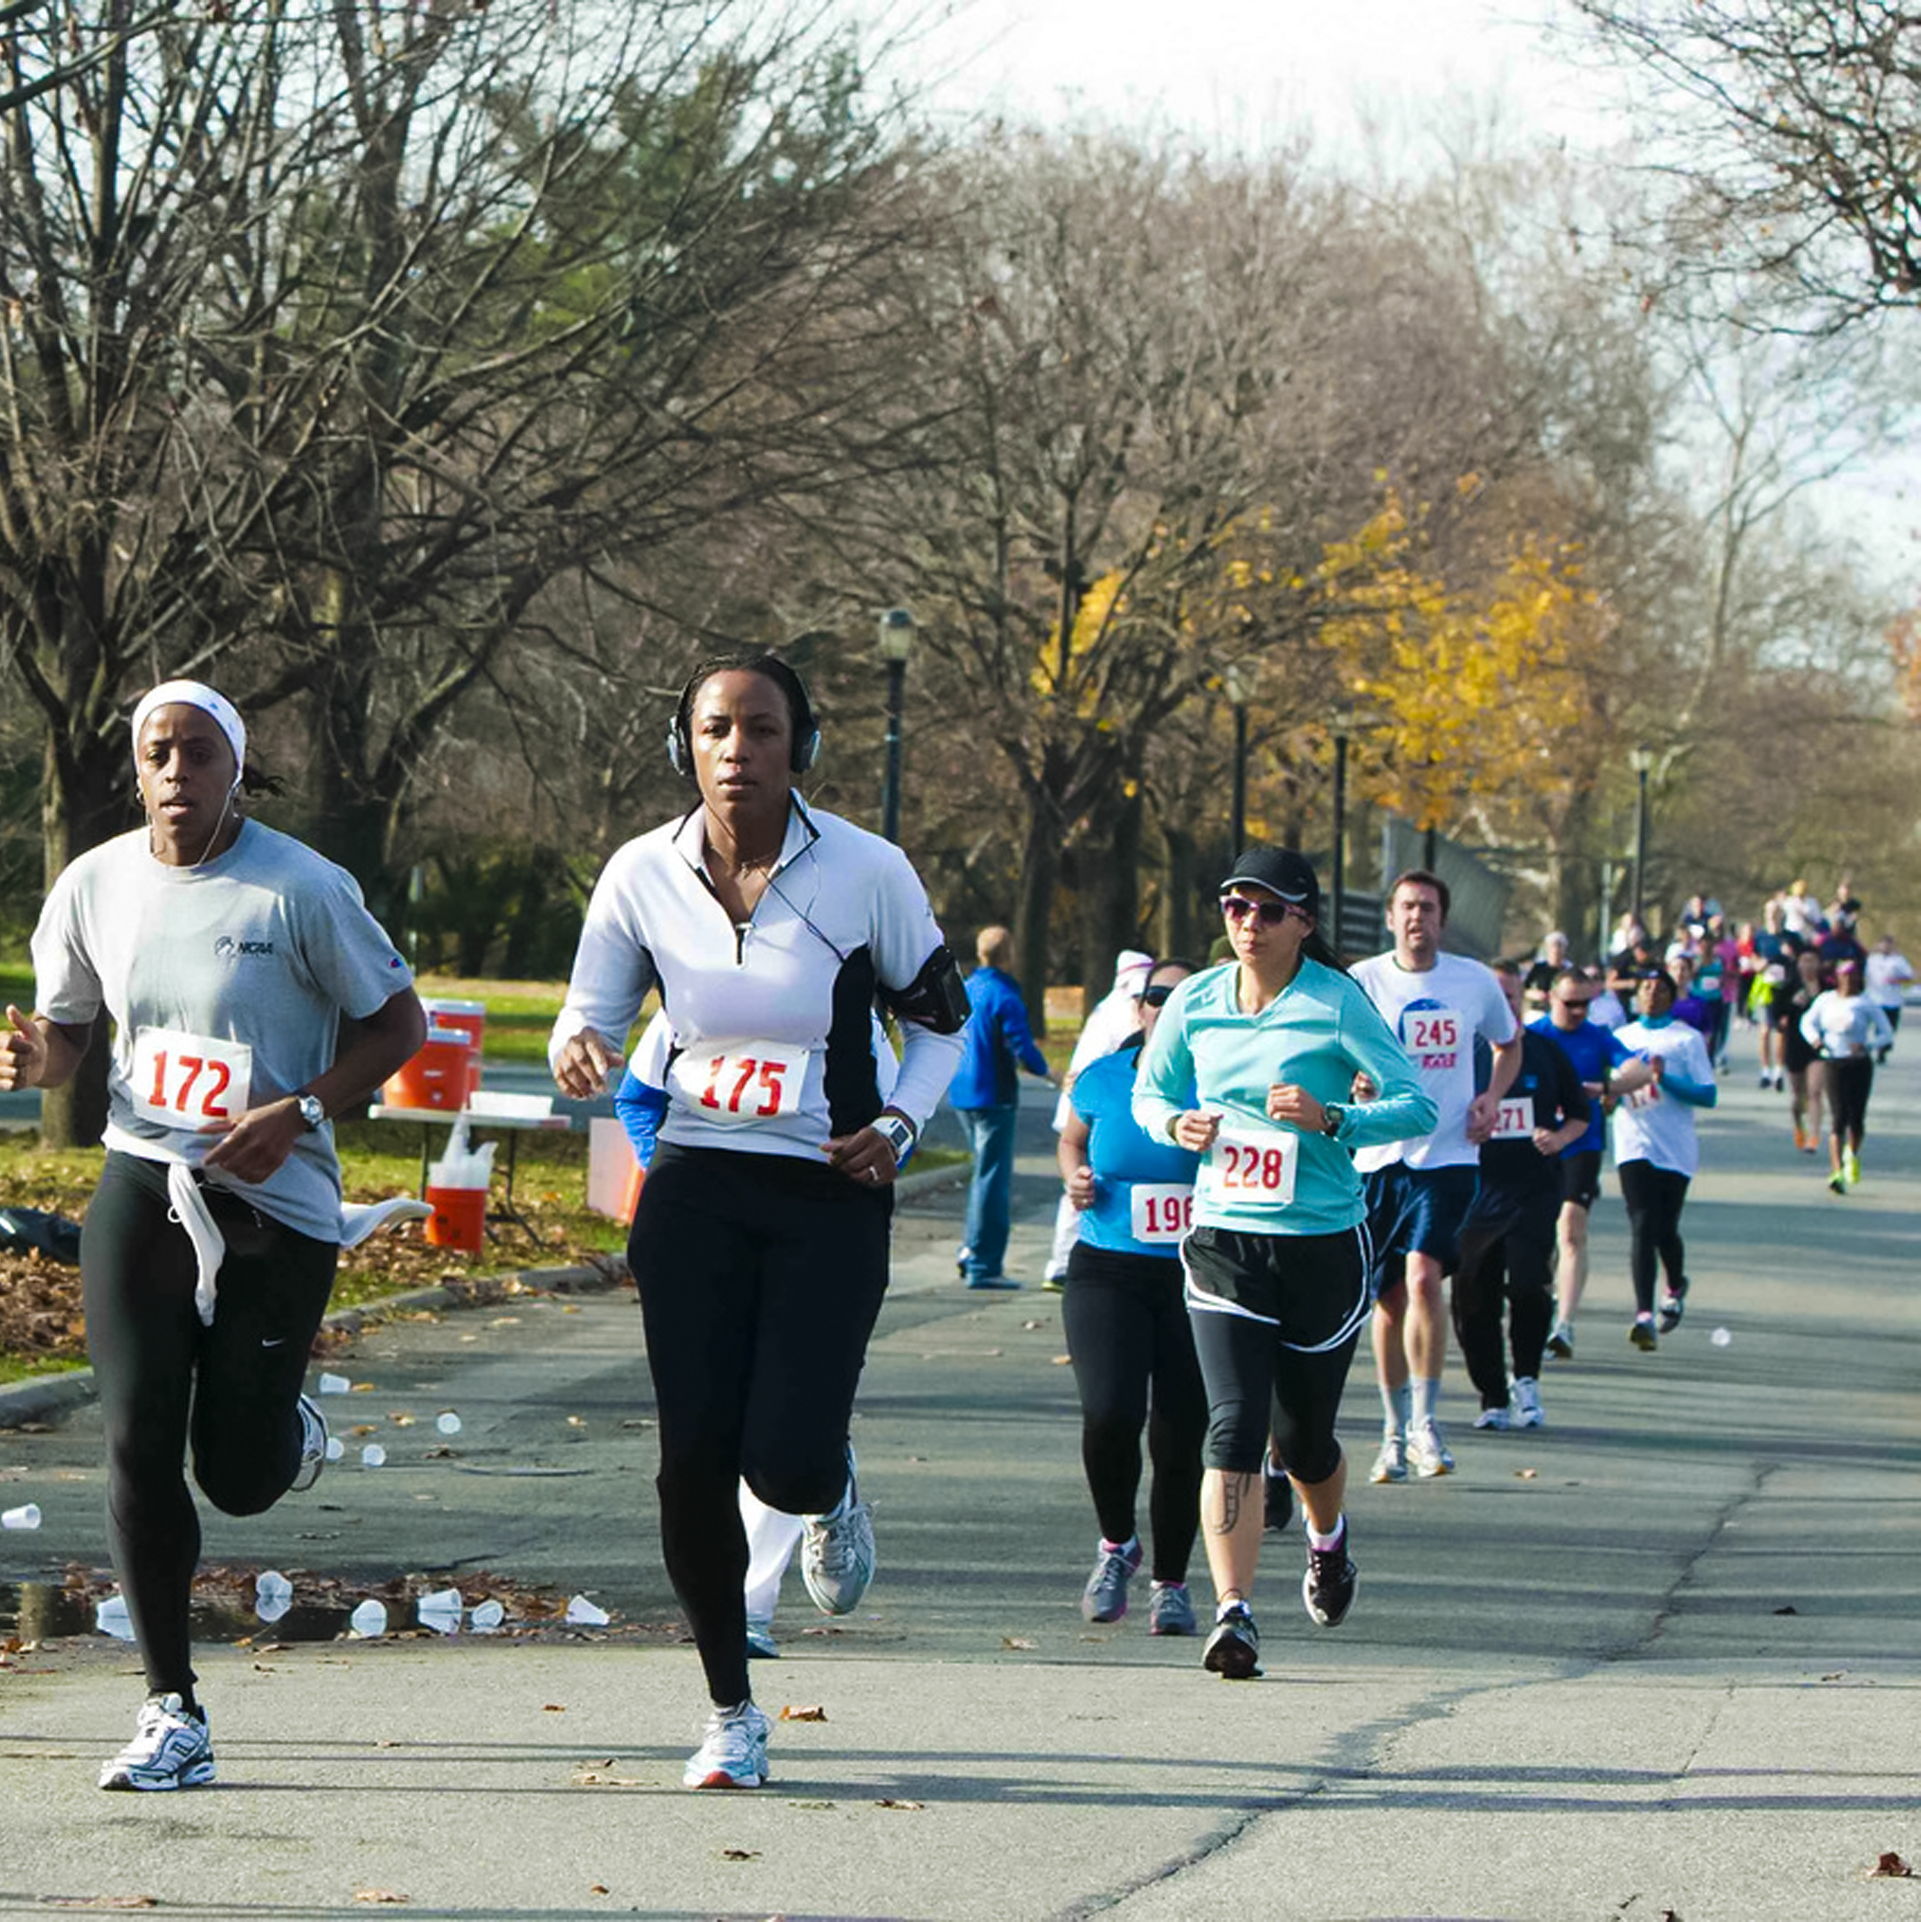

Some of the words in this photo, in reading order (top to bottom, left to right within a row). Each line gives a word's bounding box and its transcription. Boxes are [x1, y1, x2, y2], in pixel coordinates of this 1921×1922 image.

[1414, 1018, 1456, 1048] 245
[148, 1050, 231, 1117] 172
[700, 1055, 787, 1116] 175
[1222, 1145, 1283, 1190] 228
